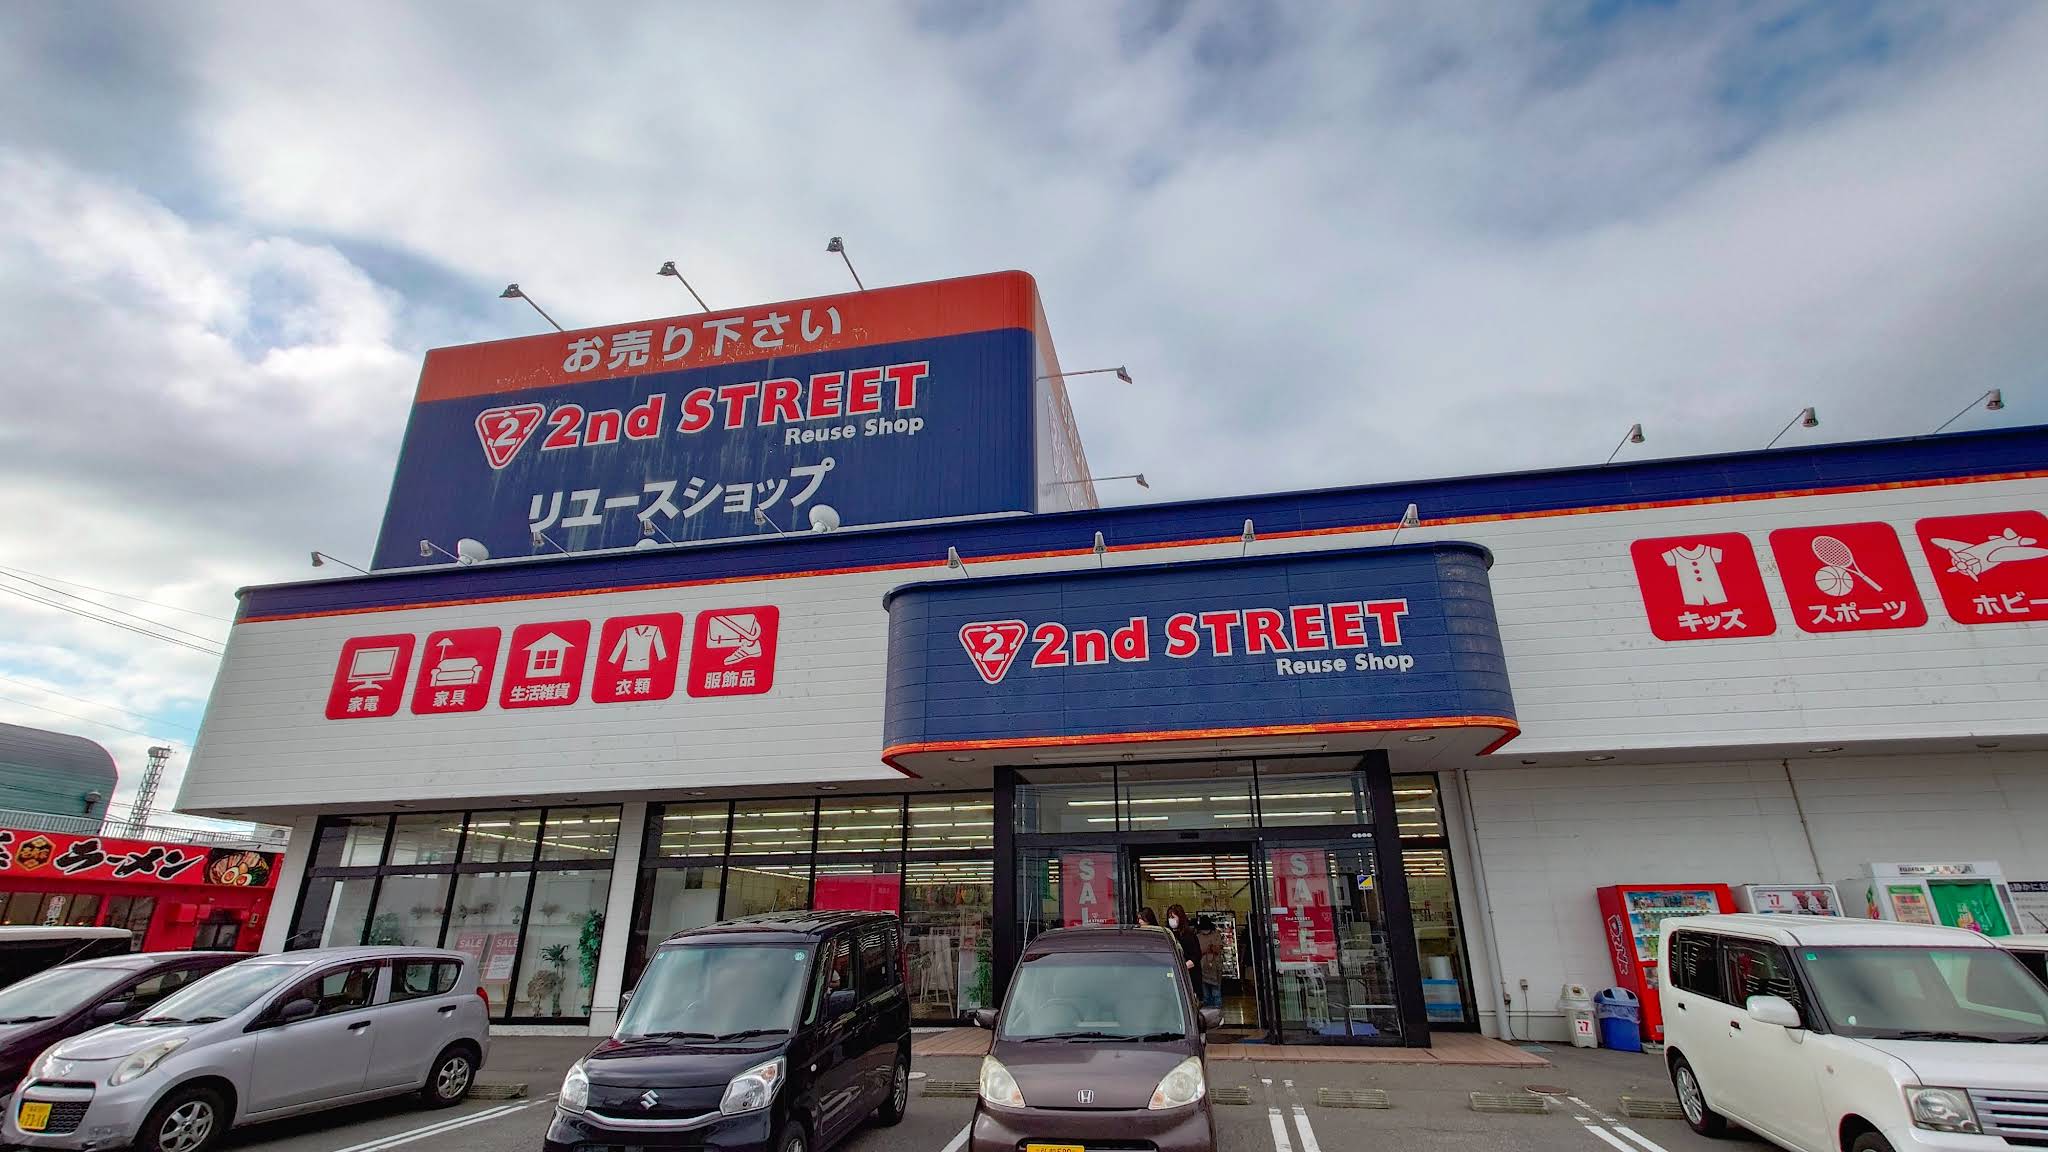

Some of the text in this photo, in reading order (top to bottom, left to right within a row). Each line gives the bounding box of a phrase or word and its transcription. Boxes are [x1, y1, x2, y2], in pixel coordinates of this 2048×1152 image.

[563, 306, 842, 373] お売り下さい
[541, 394, 666, 451] 2nd
[677, 360, 930, 434] STREET
[785, 415, 925, 446] Reuse Shop
[528, 456, 836, 534] リユースショップ
[1808, 600, 1907, 625] スポーツ
[1972, 592, 2048, 616] ホビー
[1678, 609, 1748, 632] キッズ
[1030, 616, 1150, 668] 2nd
[1165, 598, 1410, 658] STREET
[1276, 652, 1414, 676] Reuse Shop
[615, 676, 651, 697] 衣類
[704, 669, 756, 691] 服飾品
[346, 695, 379, 714] 家電
[432, 689, 466, 707] 家具
[510, 682, 570, 703] 生活雑貨
[53, 838, 205, 880] ラーメン
[1079, 858, 1097, 926] SAL
[459, 938, 483, 948] SALE
[496, 938, 519, 948] SALE
